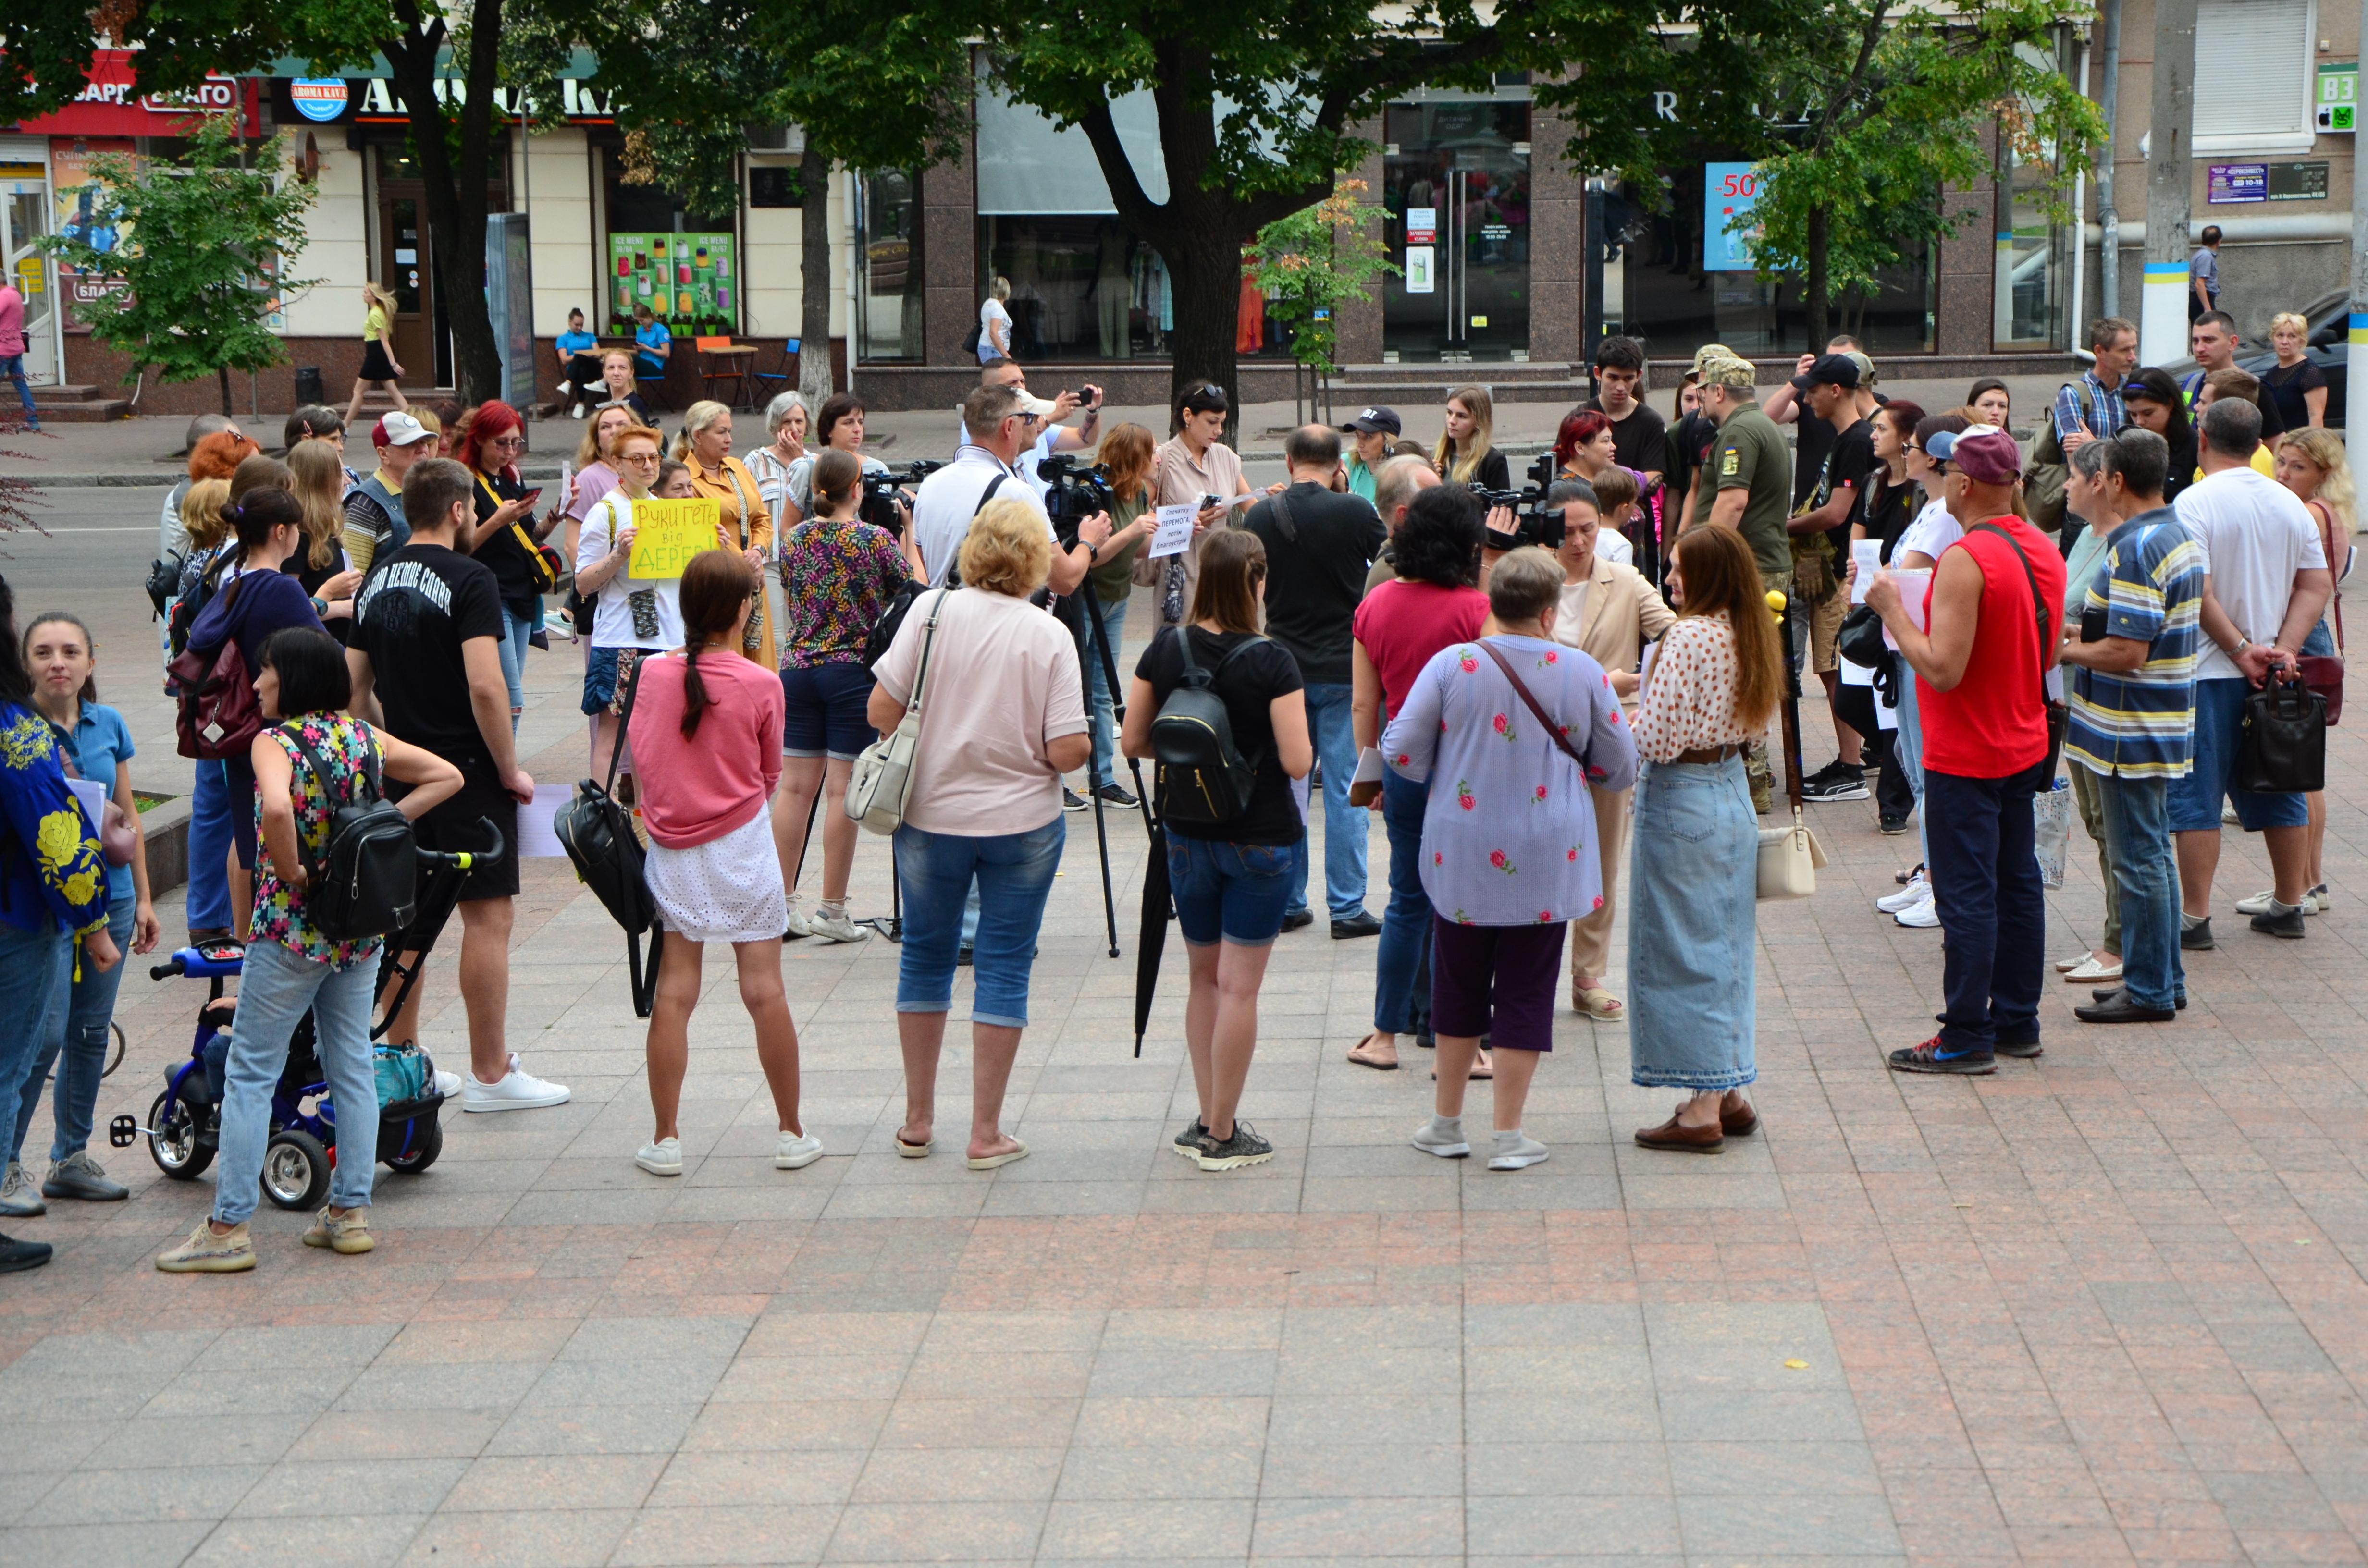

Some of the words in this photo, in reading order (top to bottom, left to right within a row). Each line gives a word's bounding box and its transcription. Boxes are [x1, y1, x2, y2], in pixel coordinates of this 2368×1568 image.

[293, 86, 322, 98] AROMA
[323, 87, 347, 98] KAVA
[307, 103, 334, 112] coffee
[1161, 517, 1190, 527] ПЕРЕМОГА,
[1168, 529, 1182, 537] потім
[1156, 537, 1187, 549] благоустрій
